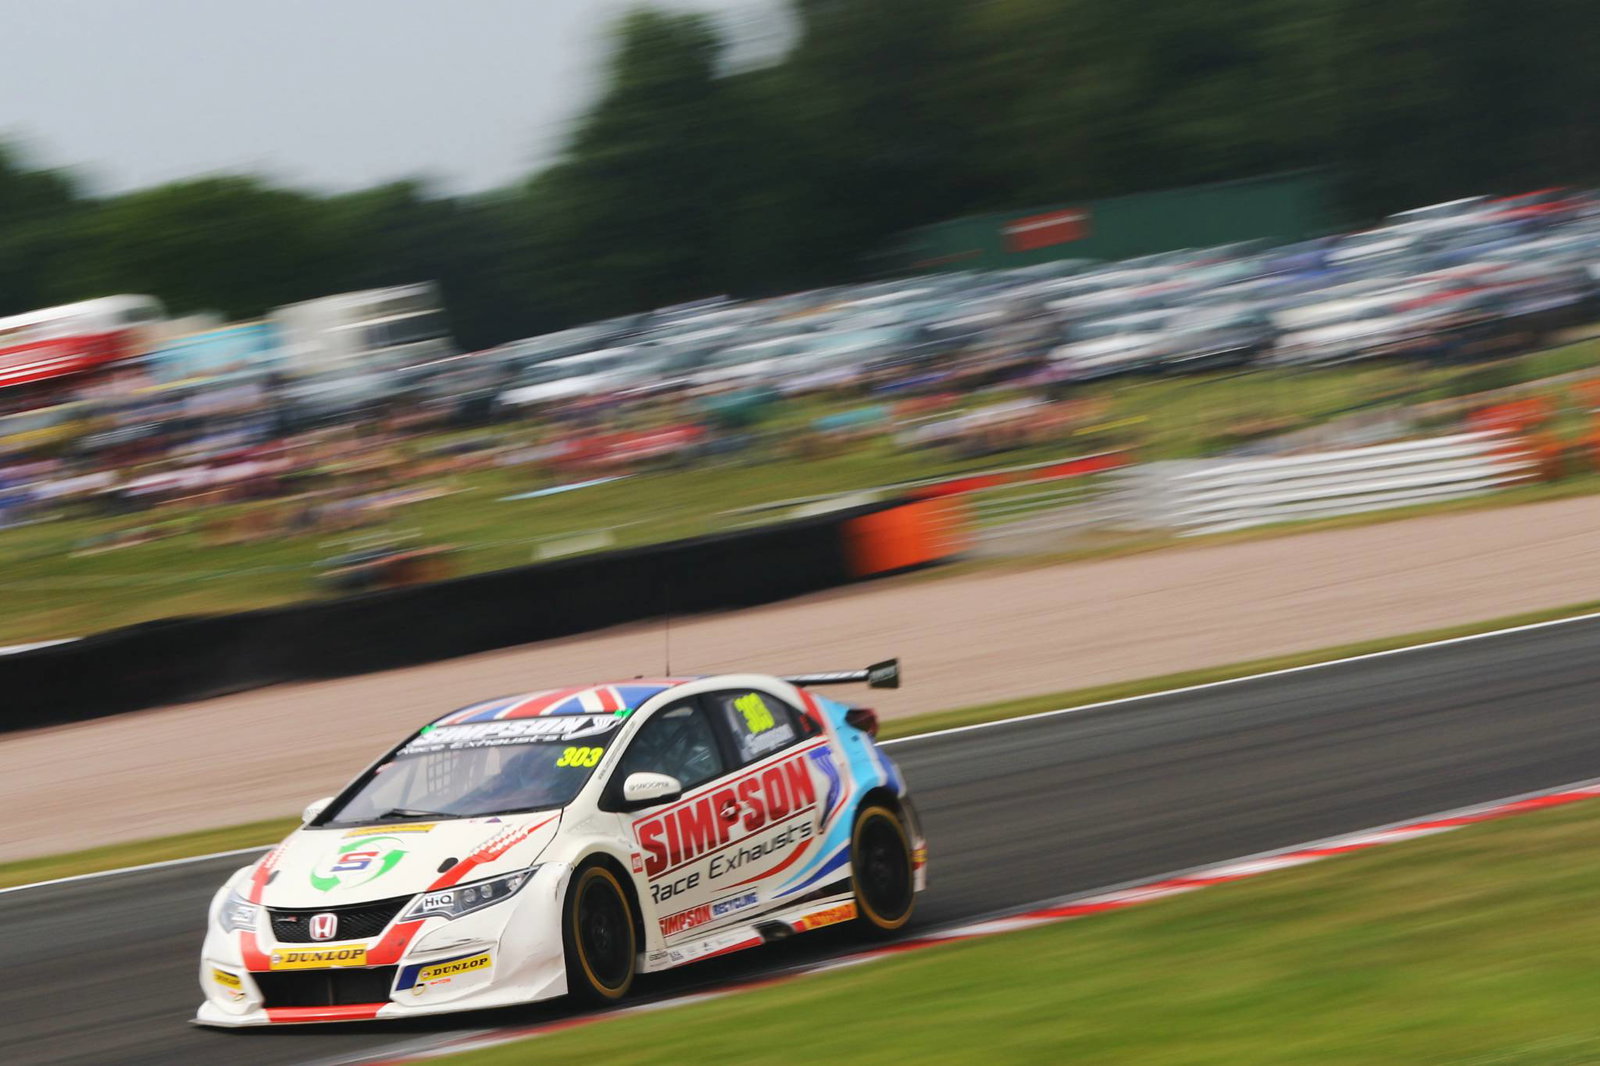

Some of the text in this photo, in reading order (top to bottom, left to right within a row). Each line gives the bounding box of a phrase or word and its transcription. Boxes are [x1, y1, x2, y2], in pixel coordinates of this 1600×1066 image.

[556, 746, 604, 768] 303
[638, 755, 818, 878] SIMPSON
[649, 820, 812, 905] Race Exhausts
[424, 894, 454, 909] HiQ
[657, 903, 712, 936] SIMPSON
[285, 948, 366, 964] DUNLOP
[432, 957, 489, 977] DUNLOP
